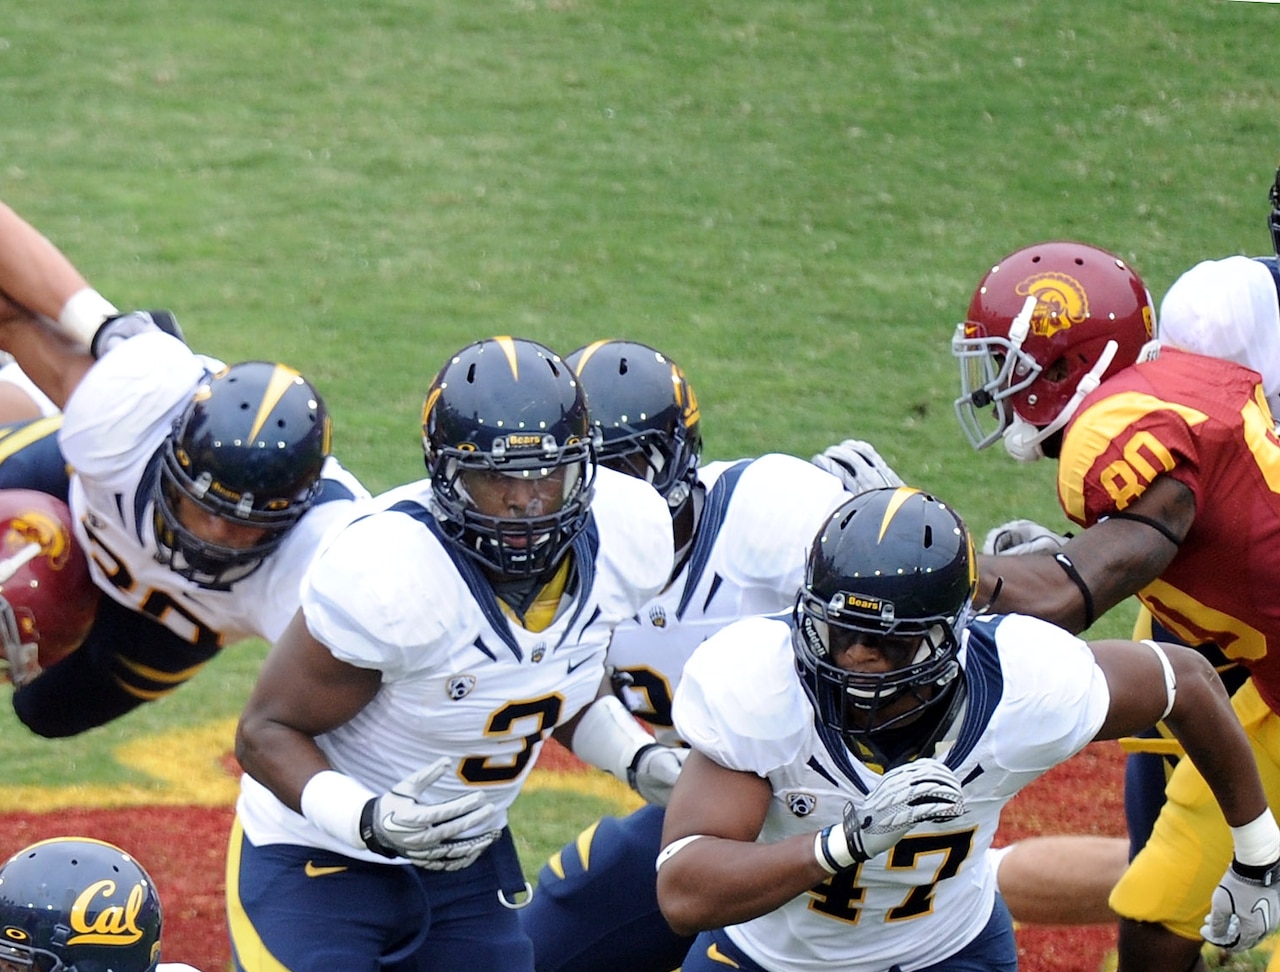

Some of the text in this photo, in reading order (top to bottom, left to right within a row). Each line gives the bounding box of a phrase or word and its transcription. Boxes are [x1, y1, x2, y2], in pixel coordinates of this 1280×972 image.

[1099, 430, 1176, 511] 80
[848, 595, 879, 610] Bears
[805, 617, 827, 656] Riddell
[456, 691, 566, 787] 3
[67, 879, 144, 946] Cal
